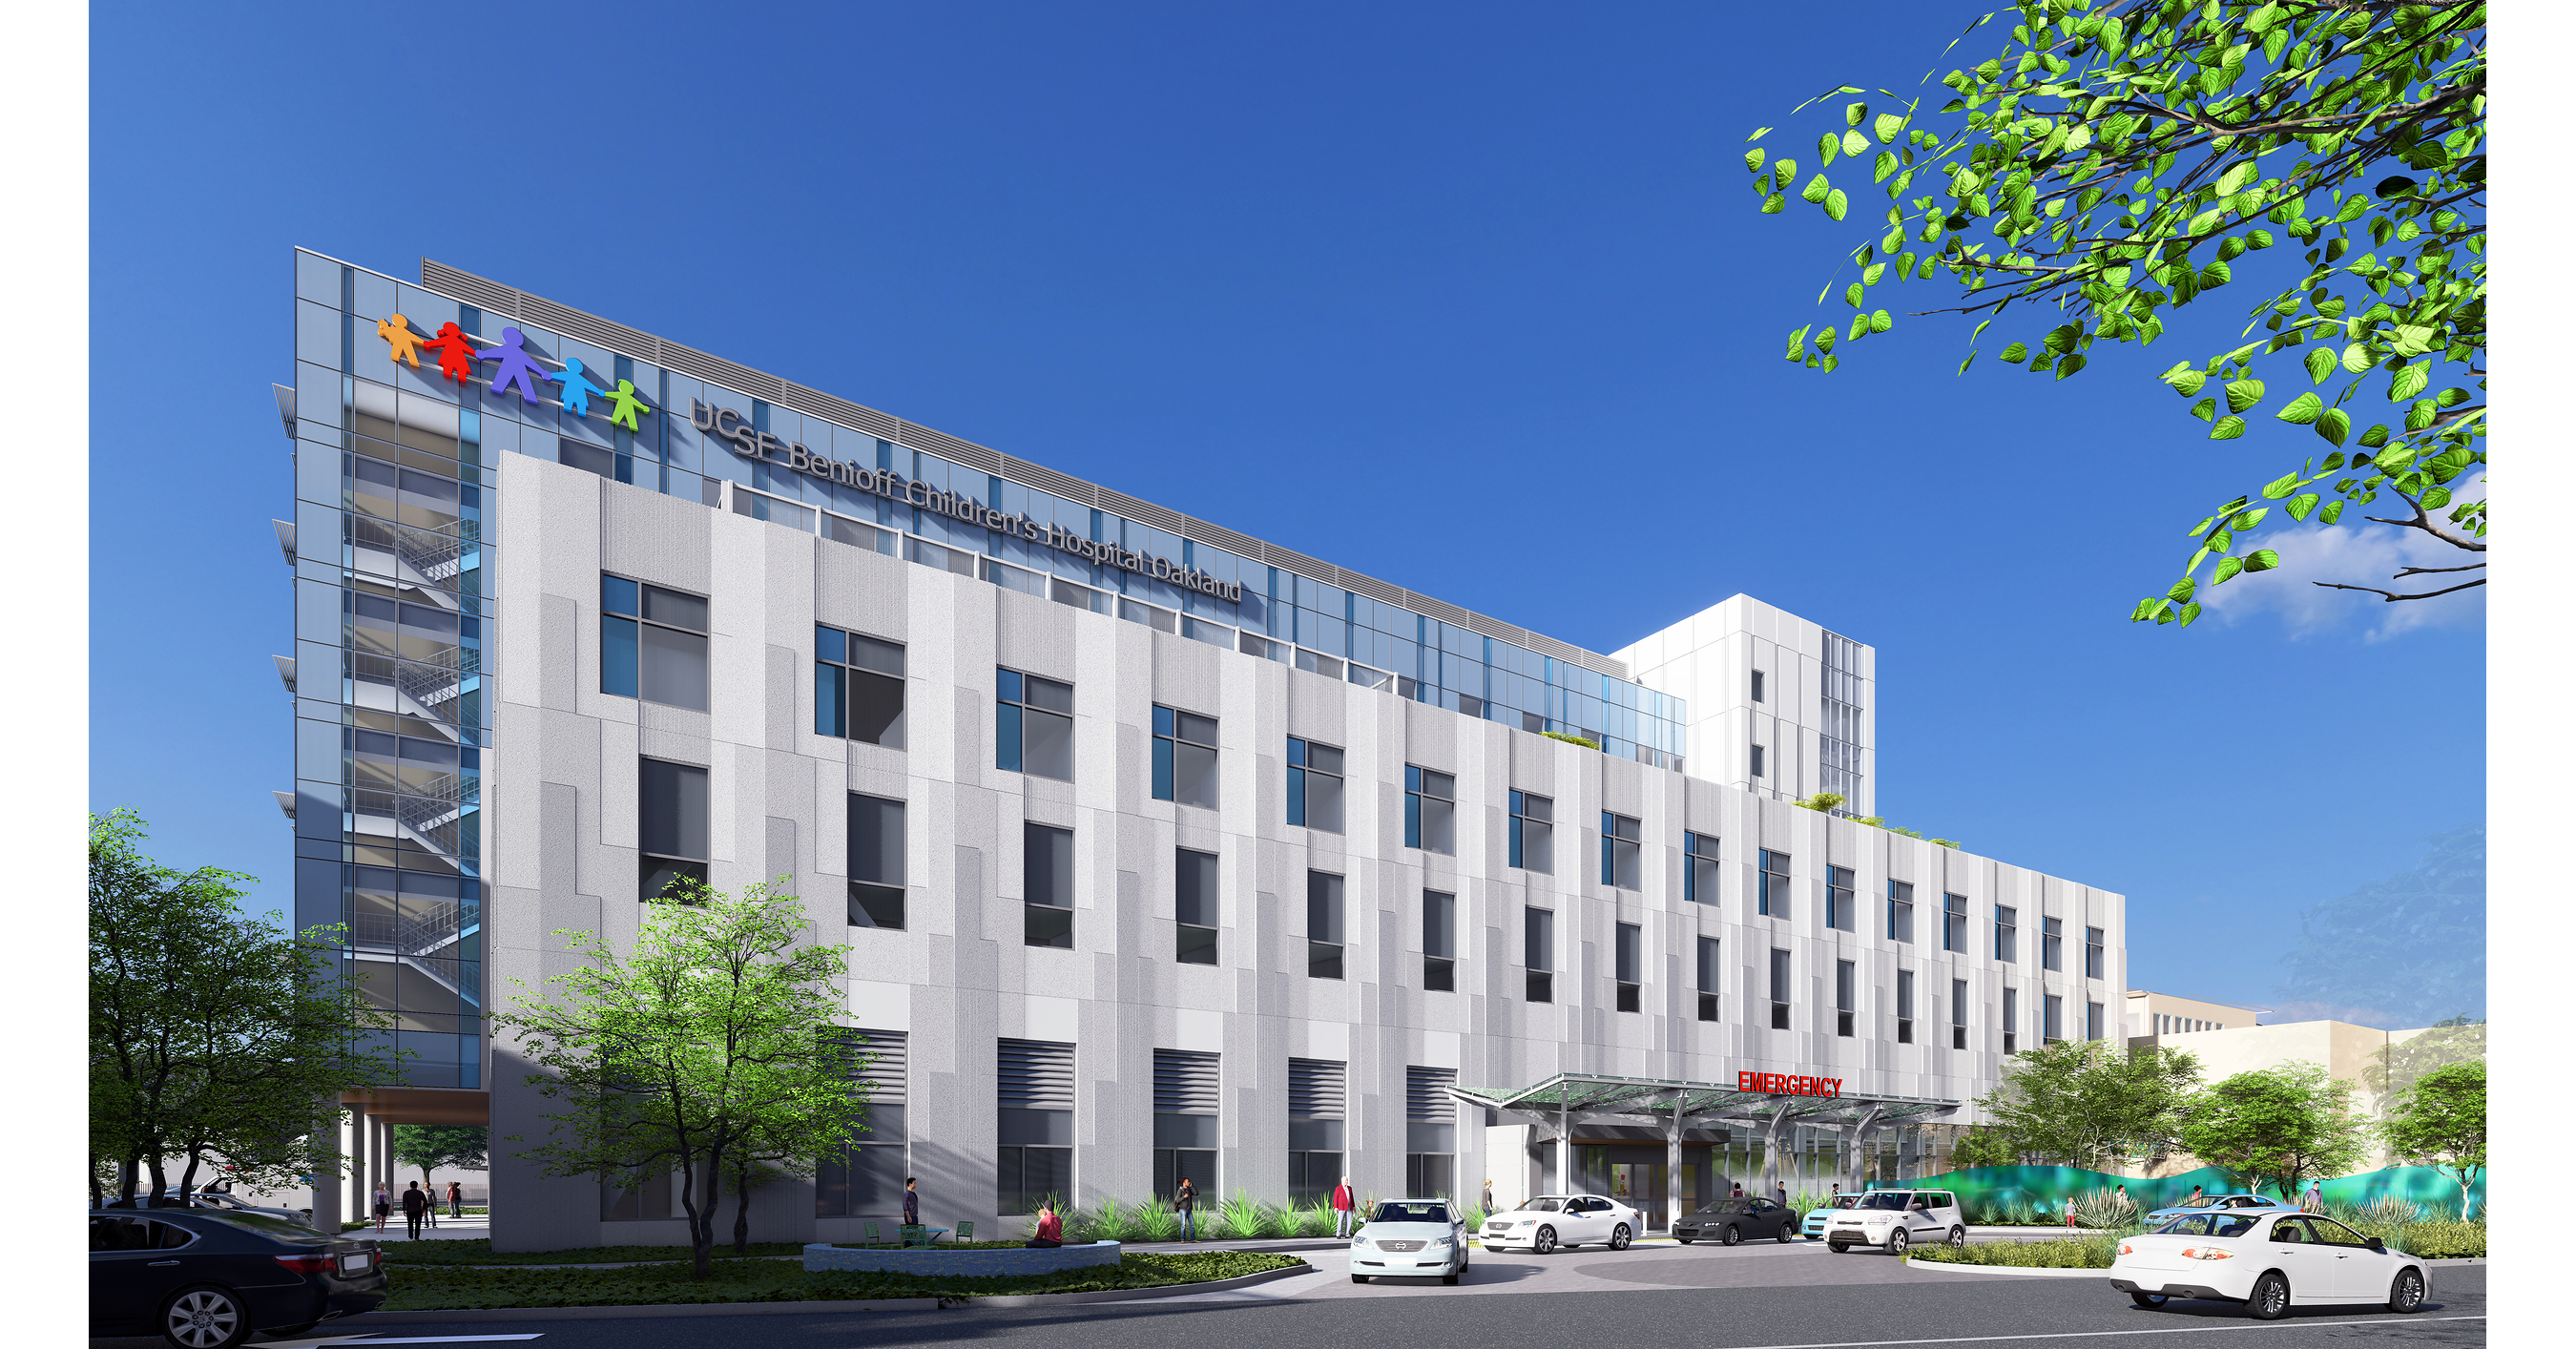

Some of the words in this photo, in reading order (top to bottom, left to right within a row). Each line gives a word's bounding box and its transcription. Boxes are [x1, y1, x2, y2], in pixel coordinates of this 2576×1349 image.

[690, 397, 776, 458] UCSF
[790, 441, 898, 497] Benioff
[905, 479, 1038, 540] Children's
[1048, 521, 1145, 572] Hospital
[1153, 555, 1242, 602] Oakland
[1738, 1070, 1843, 1098] EMERGENCY
